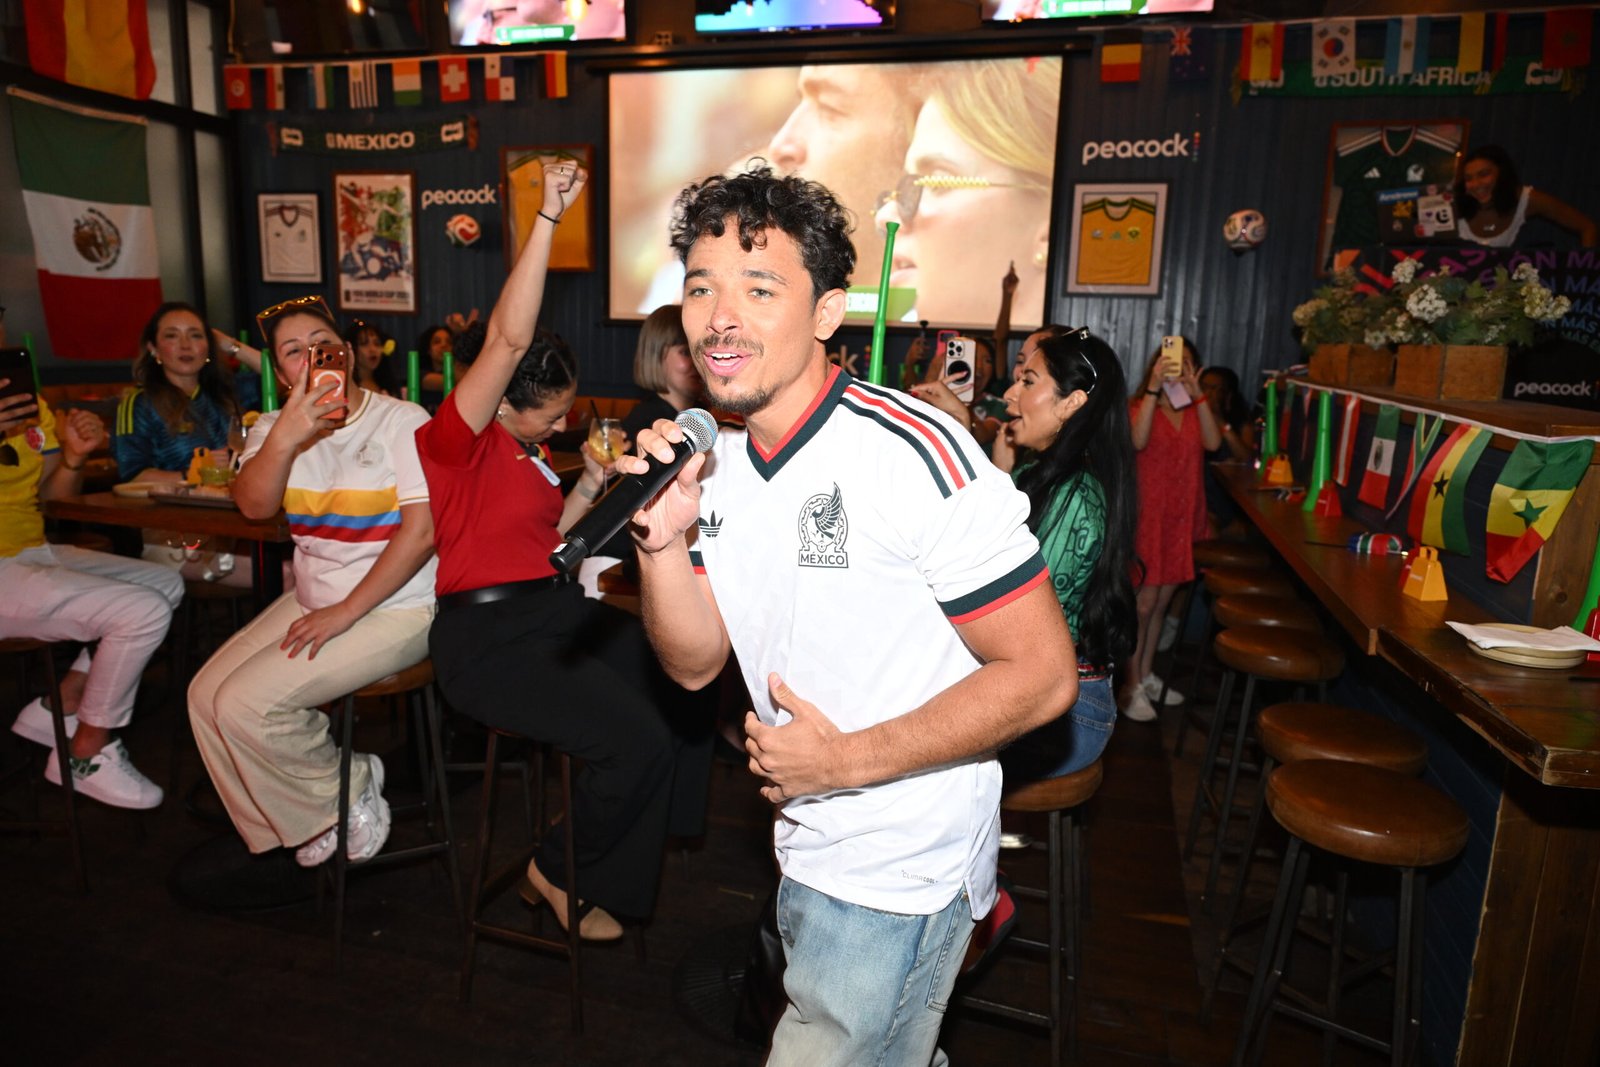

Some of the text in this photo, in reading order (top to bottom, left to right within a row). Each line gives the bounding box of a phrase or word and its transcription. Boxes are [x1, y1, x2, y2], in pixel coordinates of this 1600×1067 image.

[336, 131, 416, 151] MEXICO
[1081, 132, 1190, 166] peacock
[421, 183, 497, 210] peacock
[1513, 379, 1592, 398] peacock
[800, 551, 845, 565] MÉXICO
